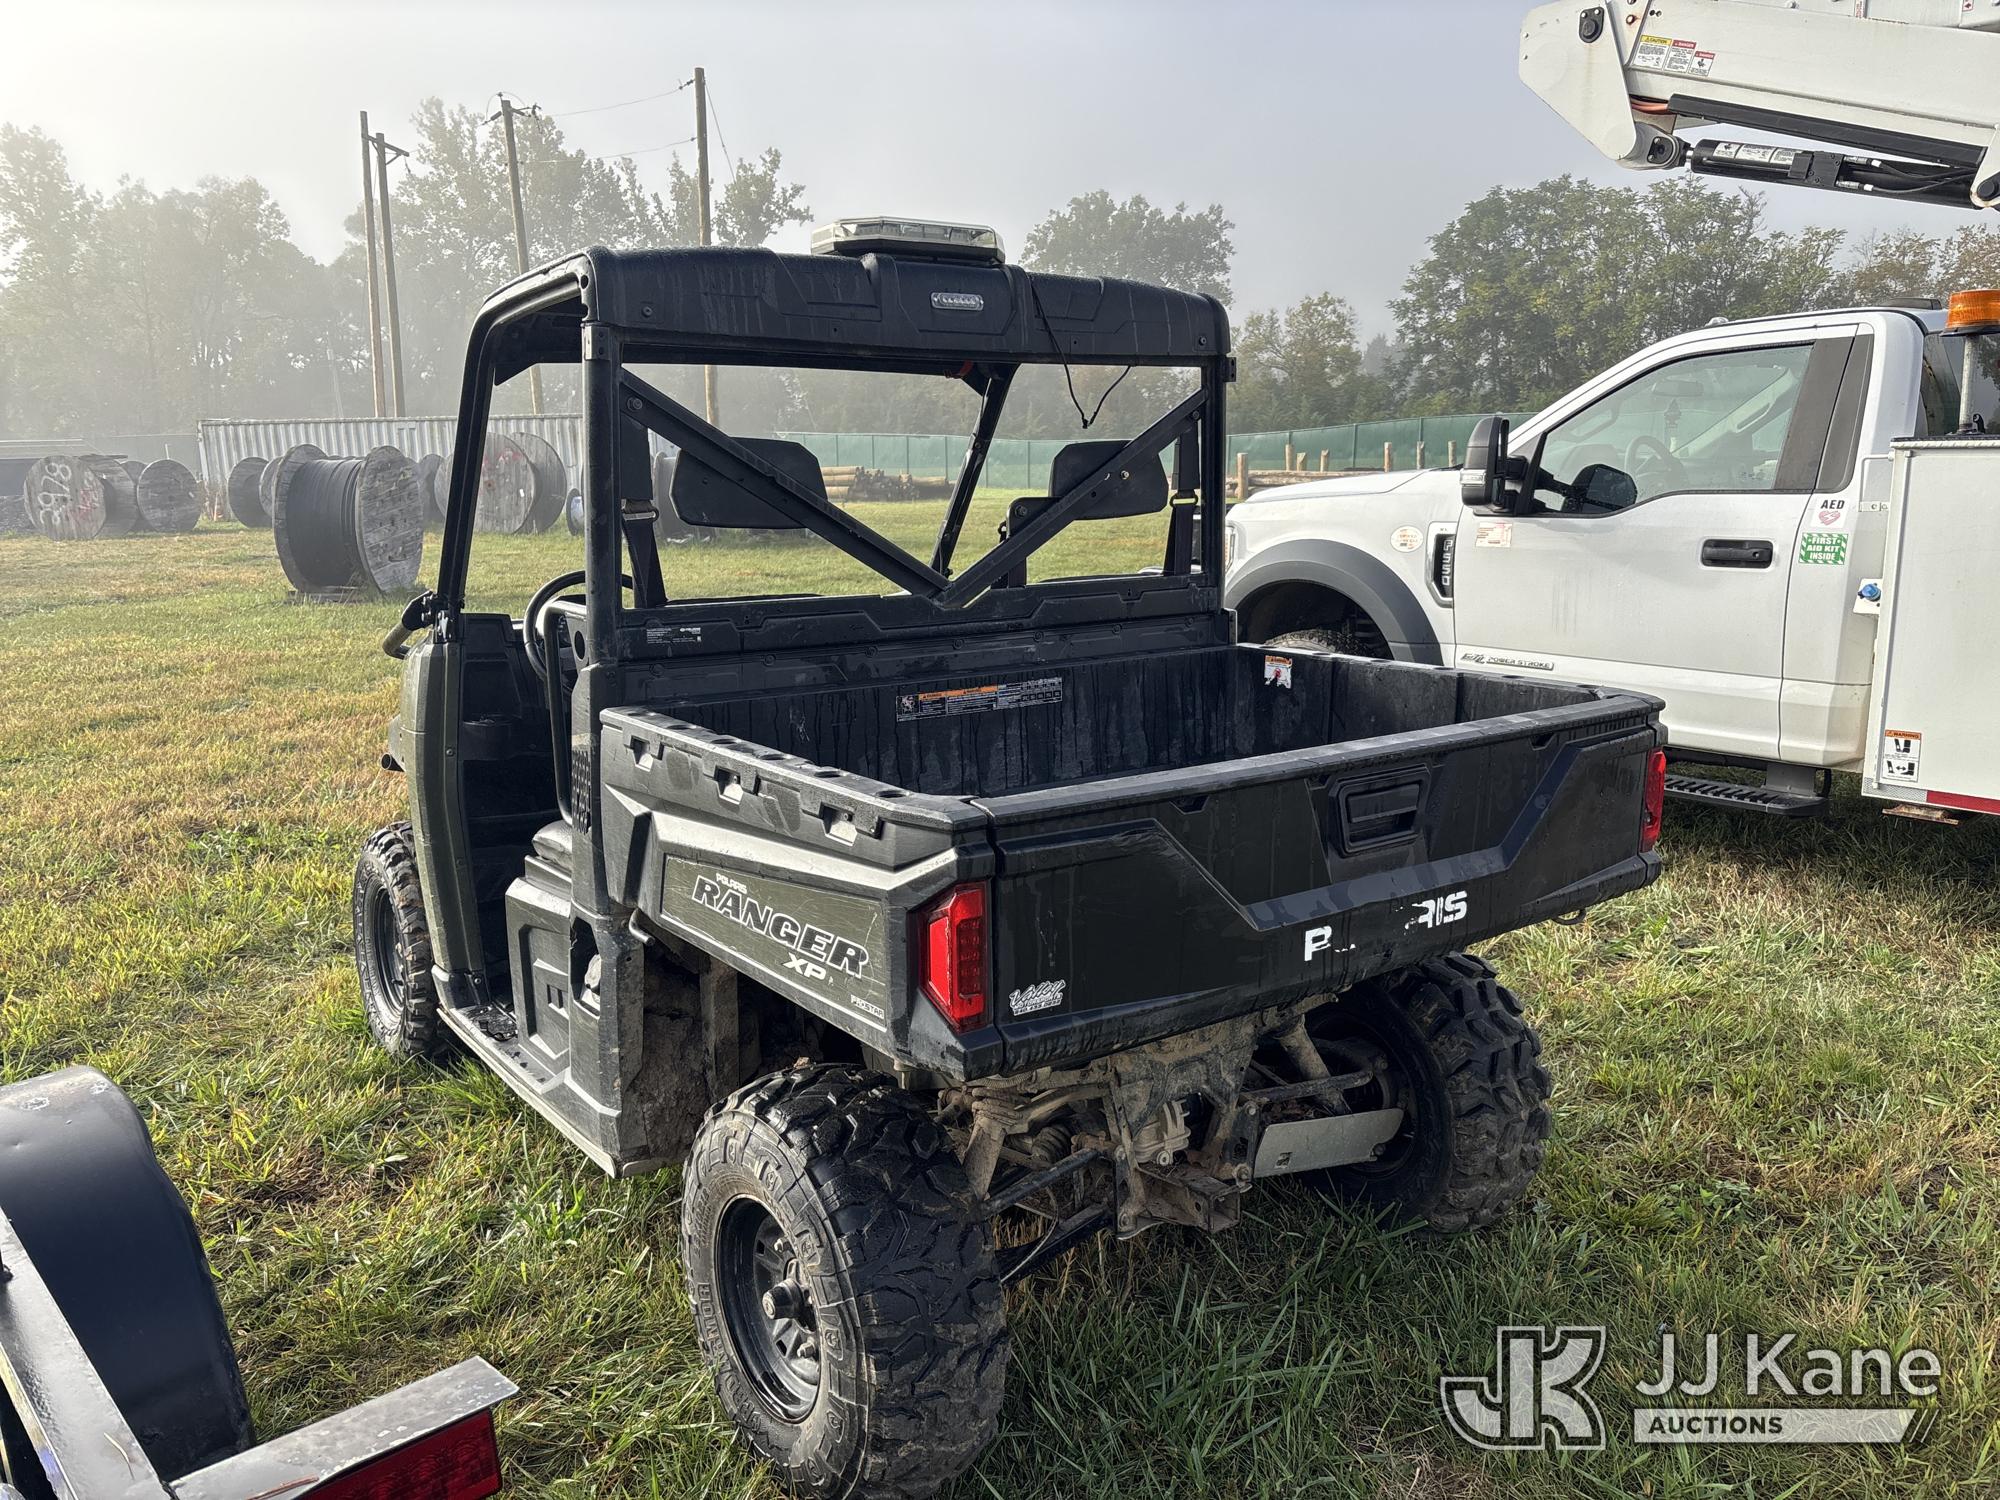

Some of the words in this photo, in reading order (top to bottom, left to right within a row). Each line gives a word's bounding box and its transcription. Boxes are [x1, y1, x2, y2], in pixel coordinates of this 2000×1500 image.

[1820, 499, 1845, 510] AED
[1811, 537, 1838, 545] FIRST
[1806, 544, 1823, 552] AID
[1824, 545, 1841, 553] KIT
[1809, 552, 1836, 560] INSIDE
[692, 875, 869, 979] RANGER
[782, 952, 827, 980] XP
